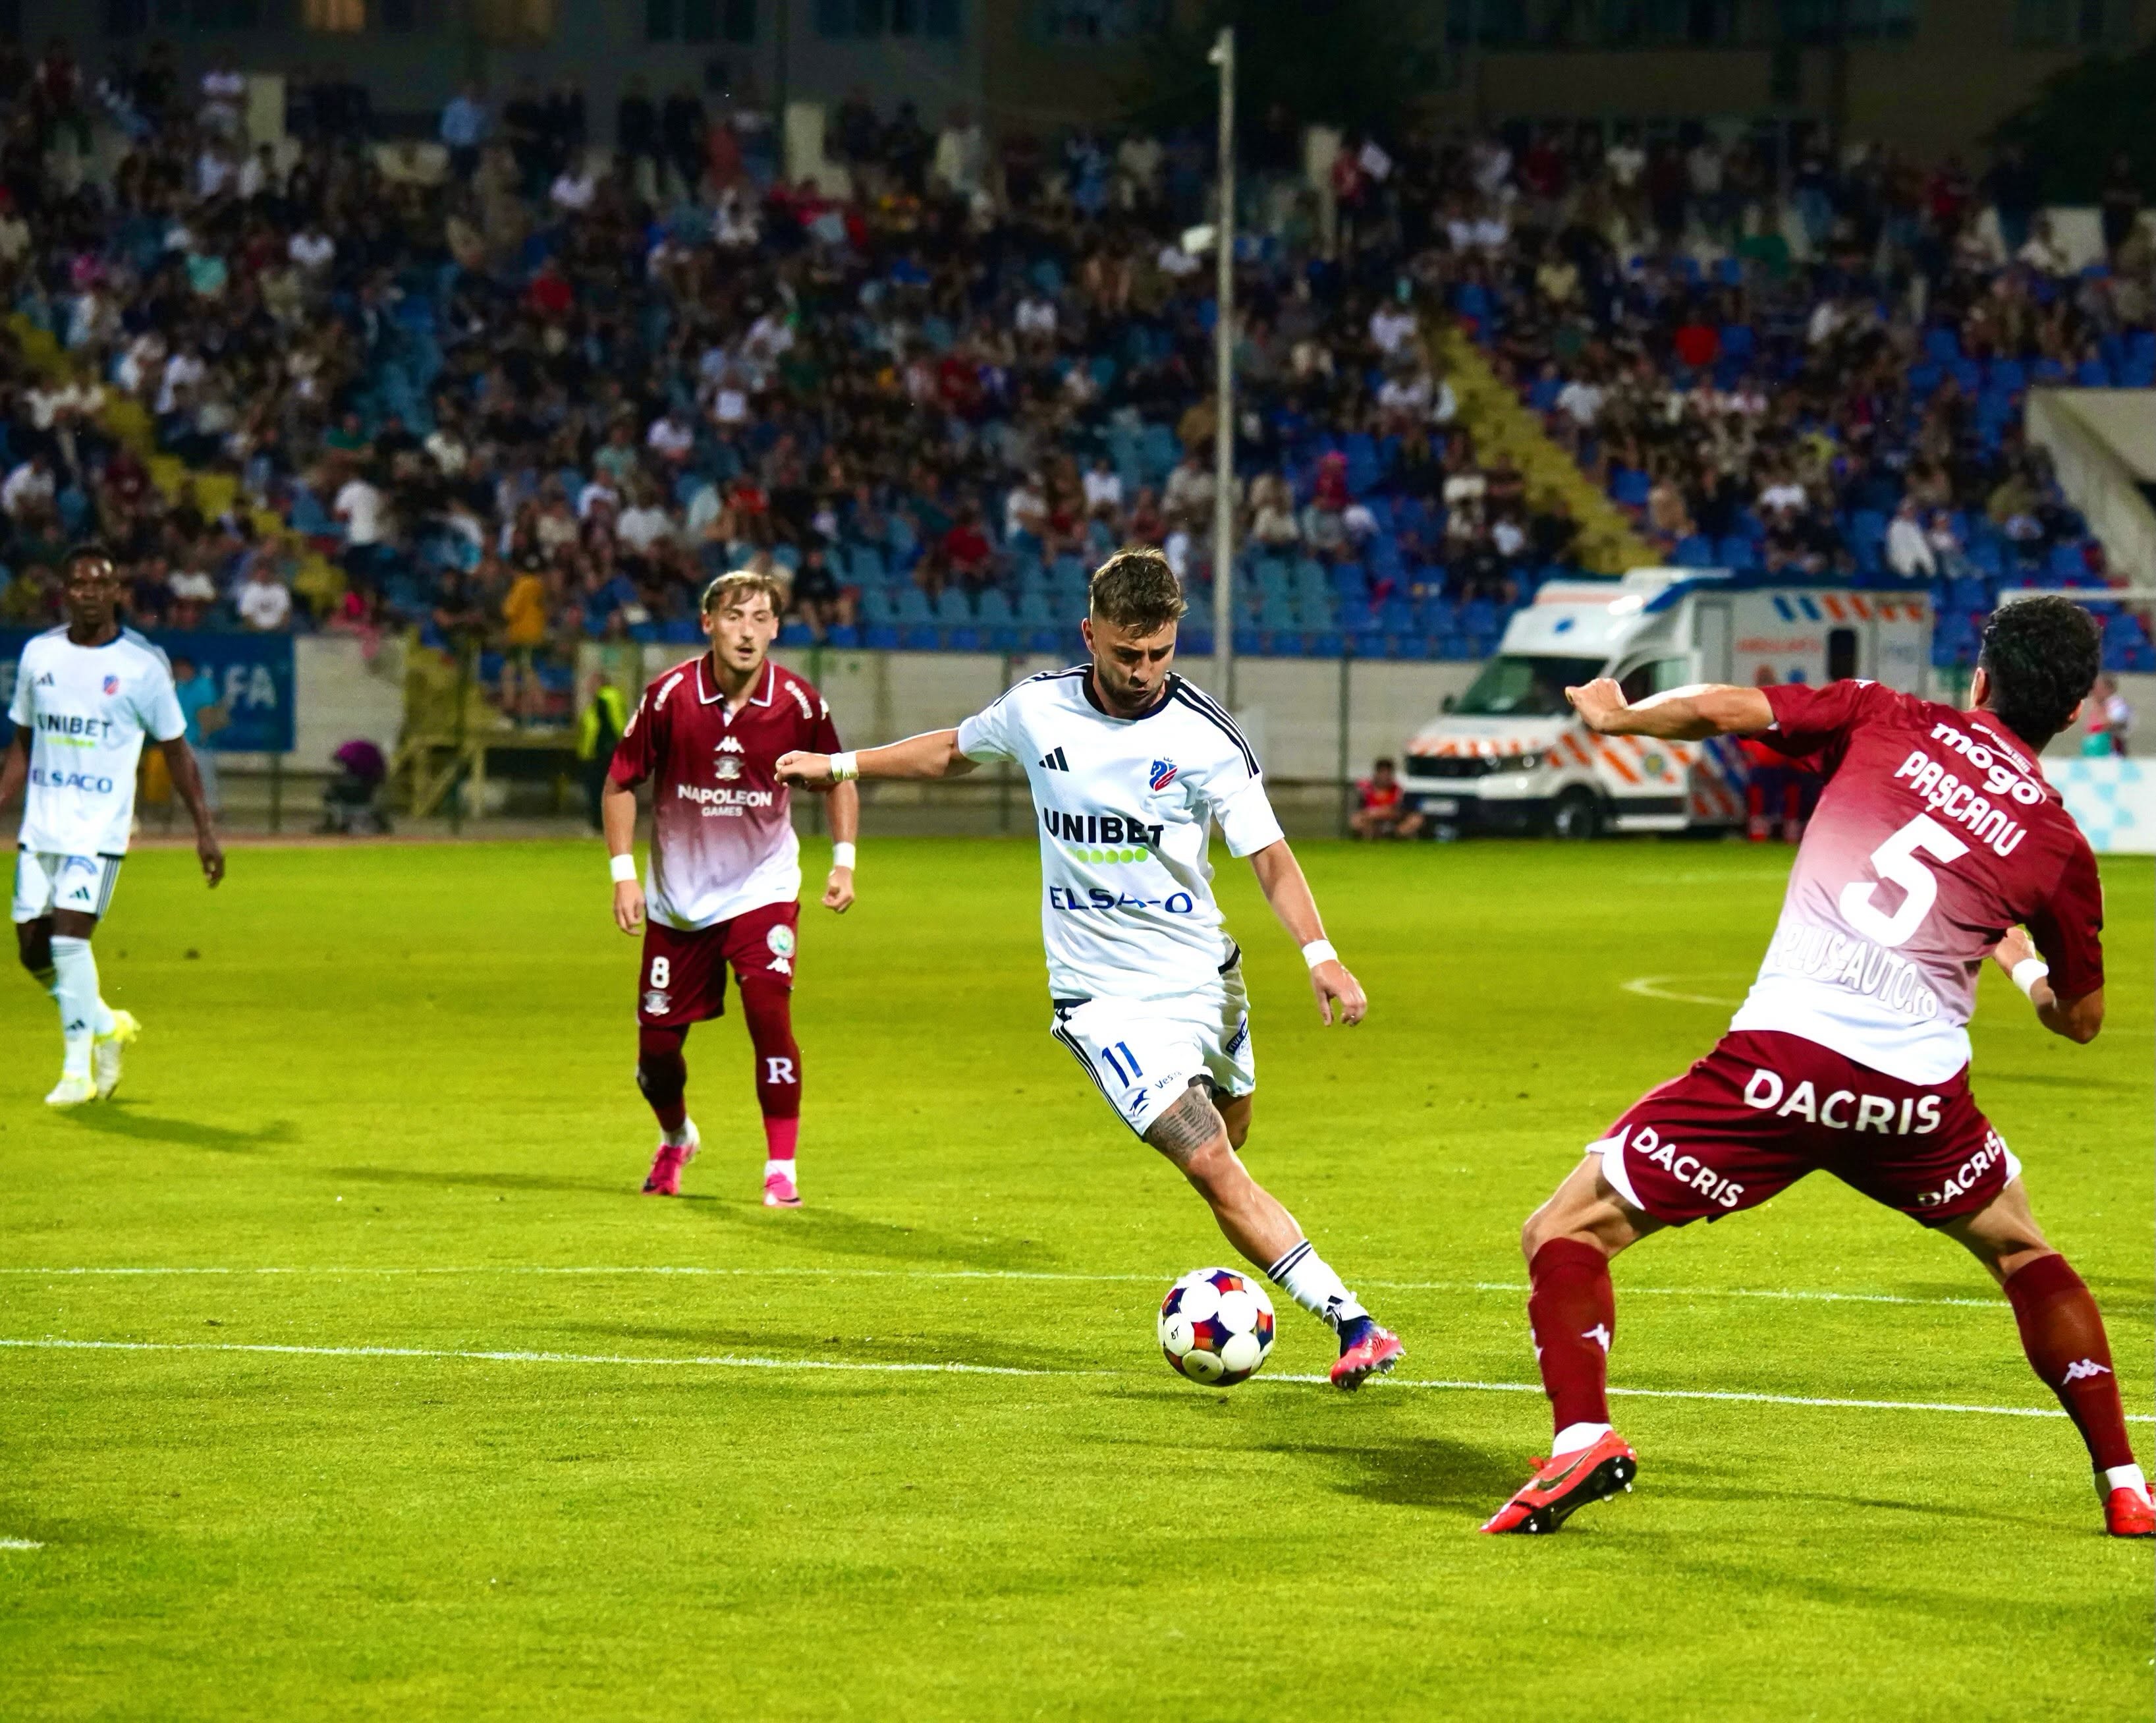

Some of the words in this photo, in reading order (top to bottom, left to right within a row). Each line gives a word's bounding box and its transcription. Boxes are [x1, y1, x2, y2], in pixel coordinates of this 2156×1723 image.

[1930, 723, 2041, 805] mogo
[677, 784, 772, 806] NAPOLEON
[702, 805, 742, 817] GAMES
[1044, 807, 1164, 848] UNIBET
[1049, 886, 1193, 913] ELSAO
[1840, 812, 1970, 947] 5
[650, 957, 670, 988] 8
[765, 1058, 796, 1084] R
[1101, 1041, 1144, 1089] 11
[1744, 1069, 1941, 1135] DACRIS
[1631, 1127, 1744, 1208] DACRIS
[1918, 1131, 2002, 1207] DACRIS
